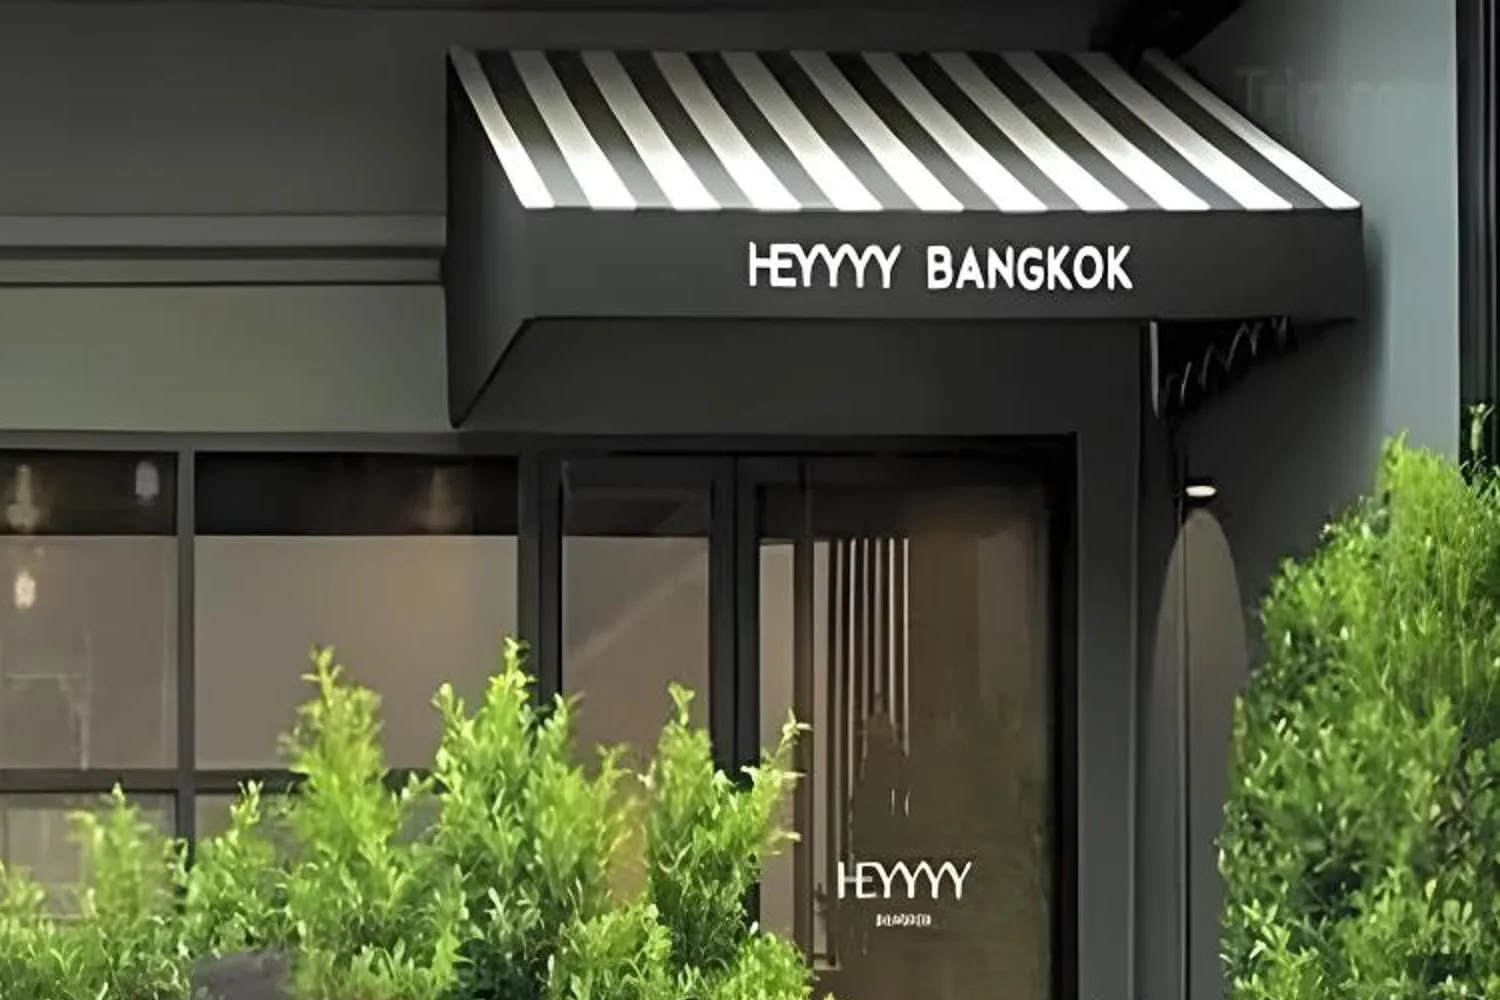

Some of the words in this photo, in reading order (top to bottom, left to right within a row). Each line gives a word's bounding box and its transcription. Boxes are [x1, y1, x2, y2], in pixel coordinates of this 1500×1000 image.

[749, 241, 901, 288] HEYYYY
[926, 244, 1133, 291] BANGKOK
[837, 860, 973, 900] HEYYYY
